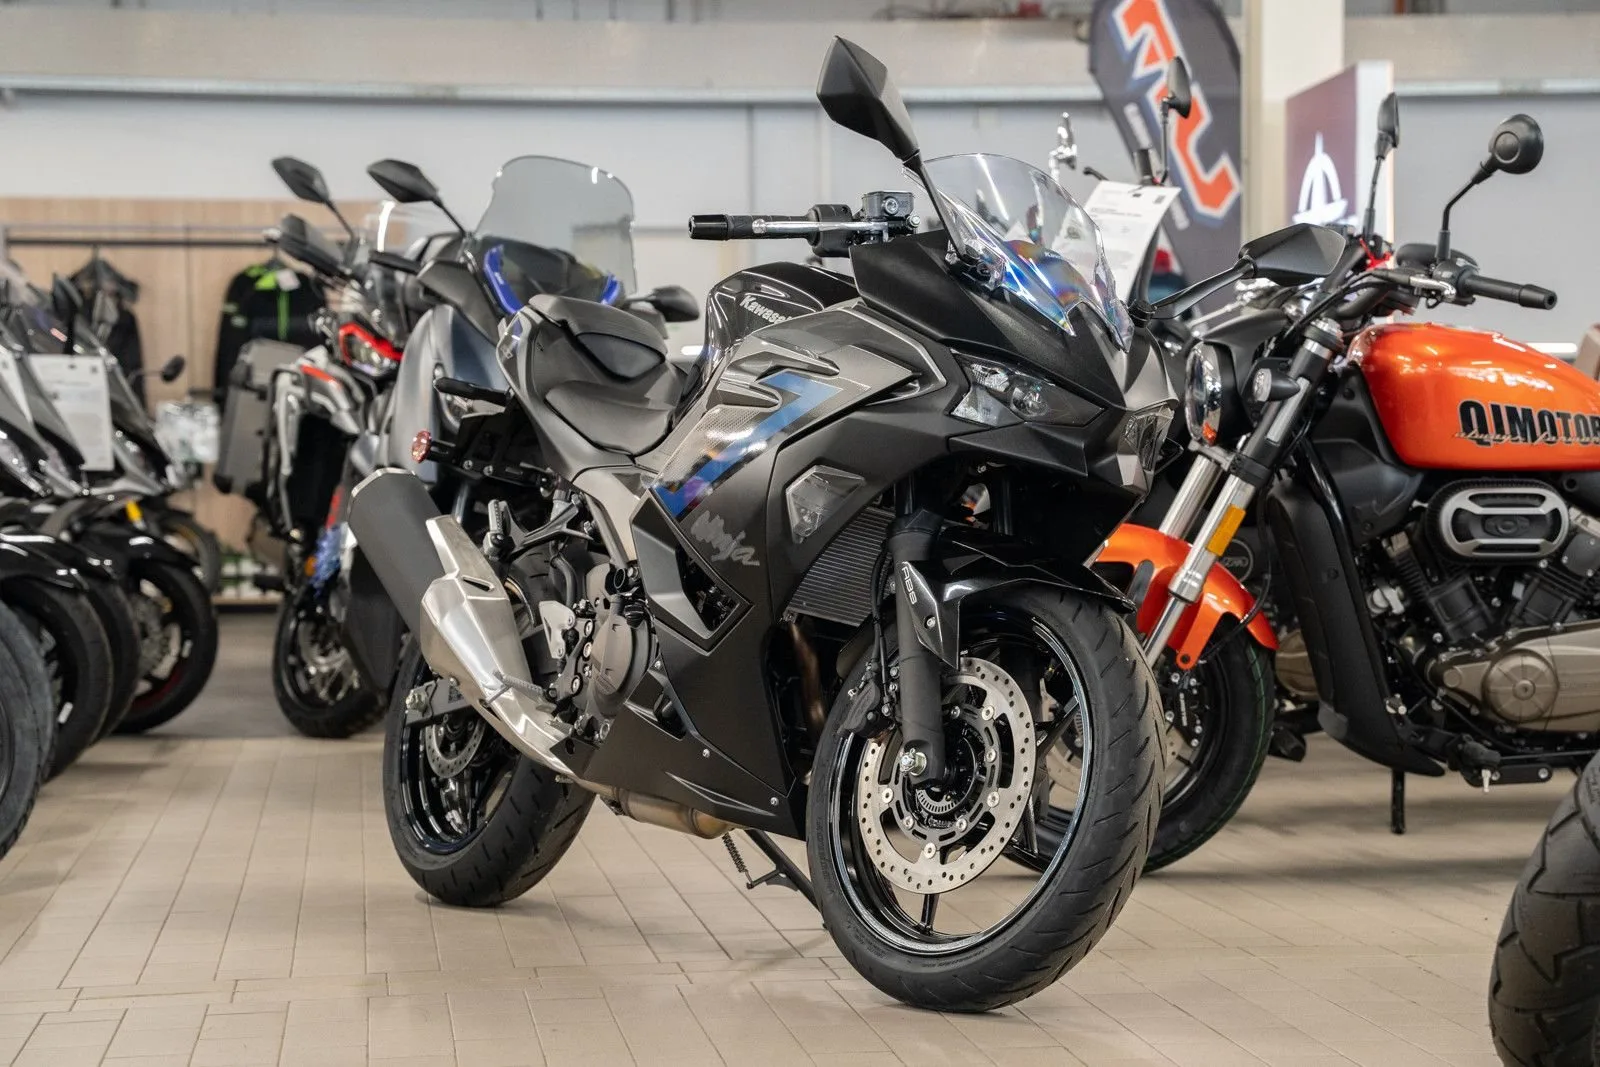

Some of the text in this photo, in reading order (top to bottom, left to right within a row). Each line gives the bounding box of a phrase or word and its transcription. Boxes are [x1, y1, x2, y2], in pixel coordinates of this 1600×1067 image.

[740, 294, 793, 324] Kawasa
[690, 510, 760, 566] Ninja
[902, 566, 918, 605] ABS
